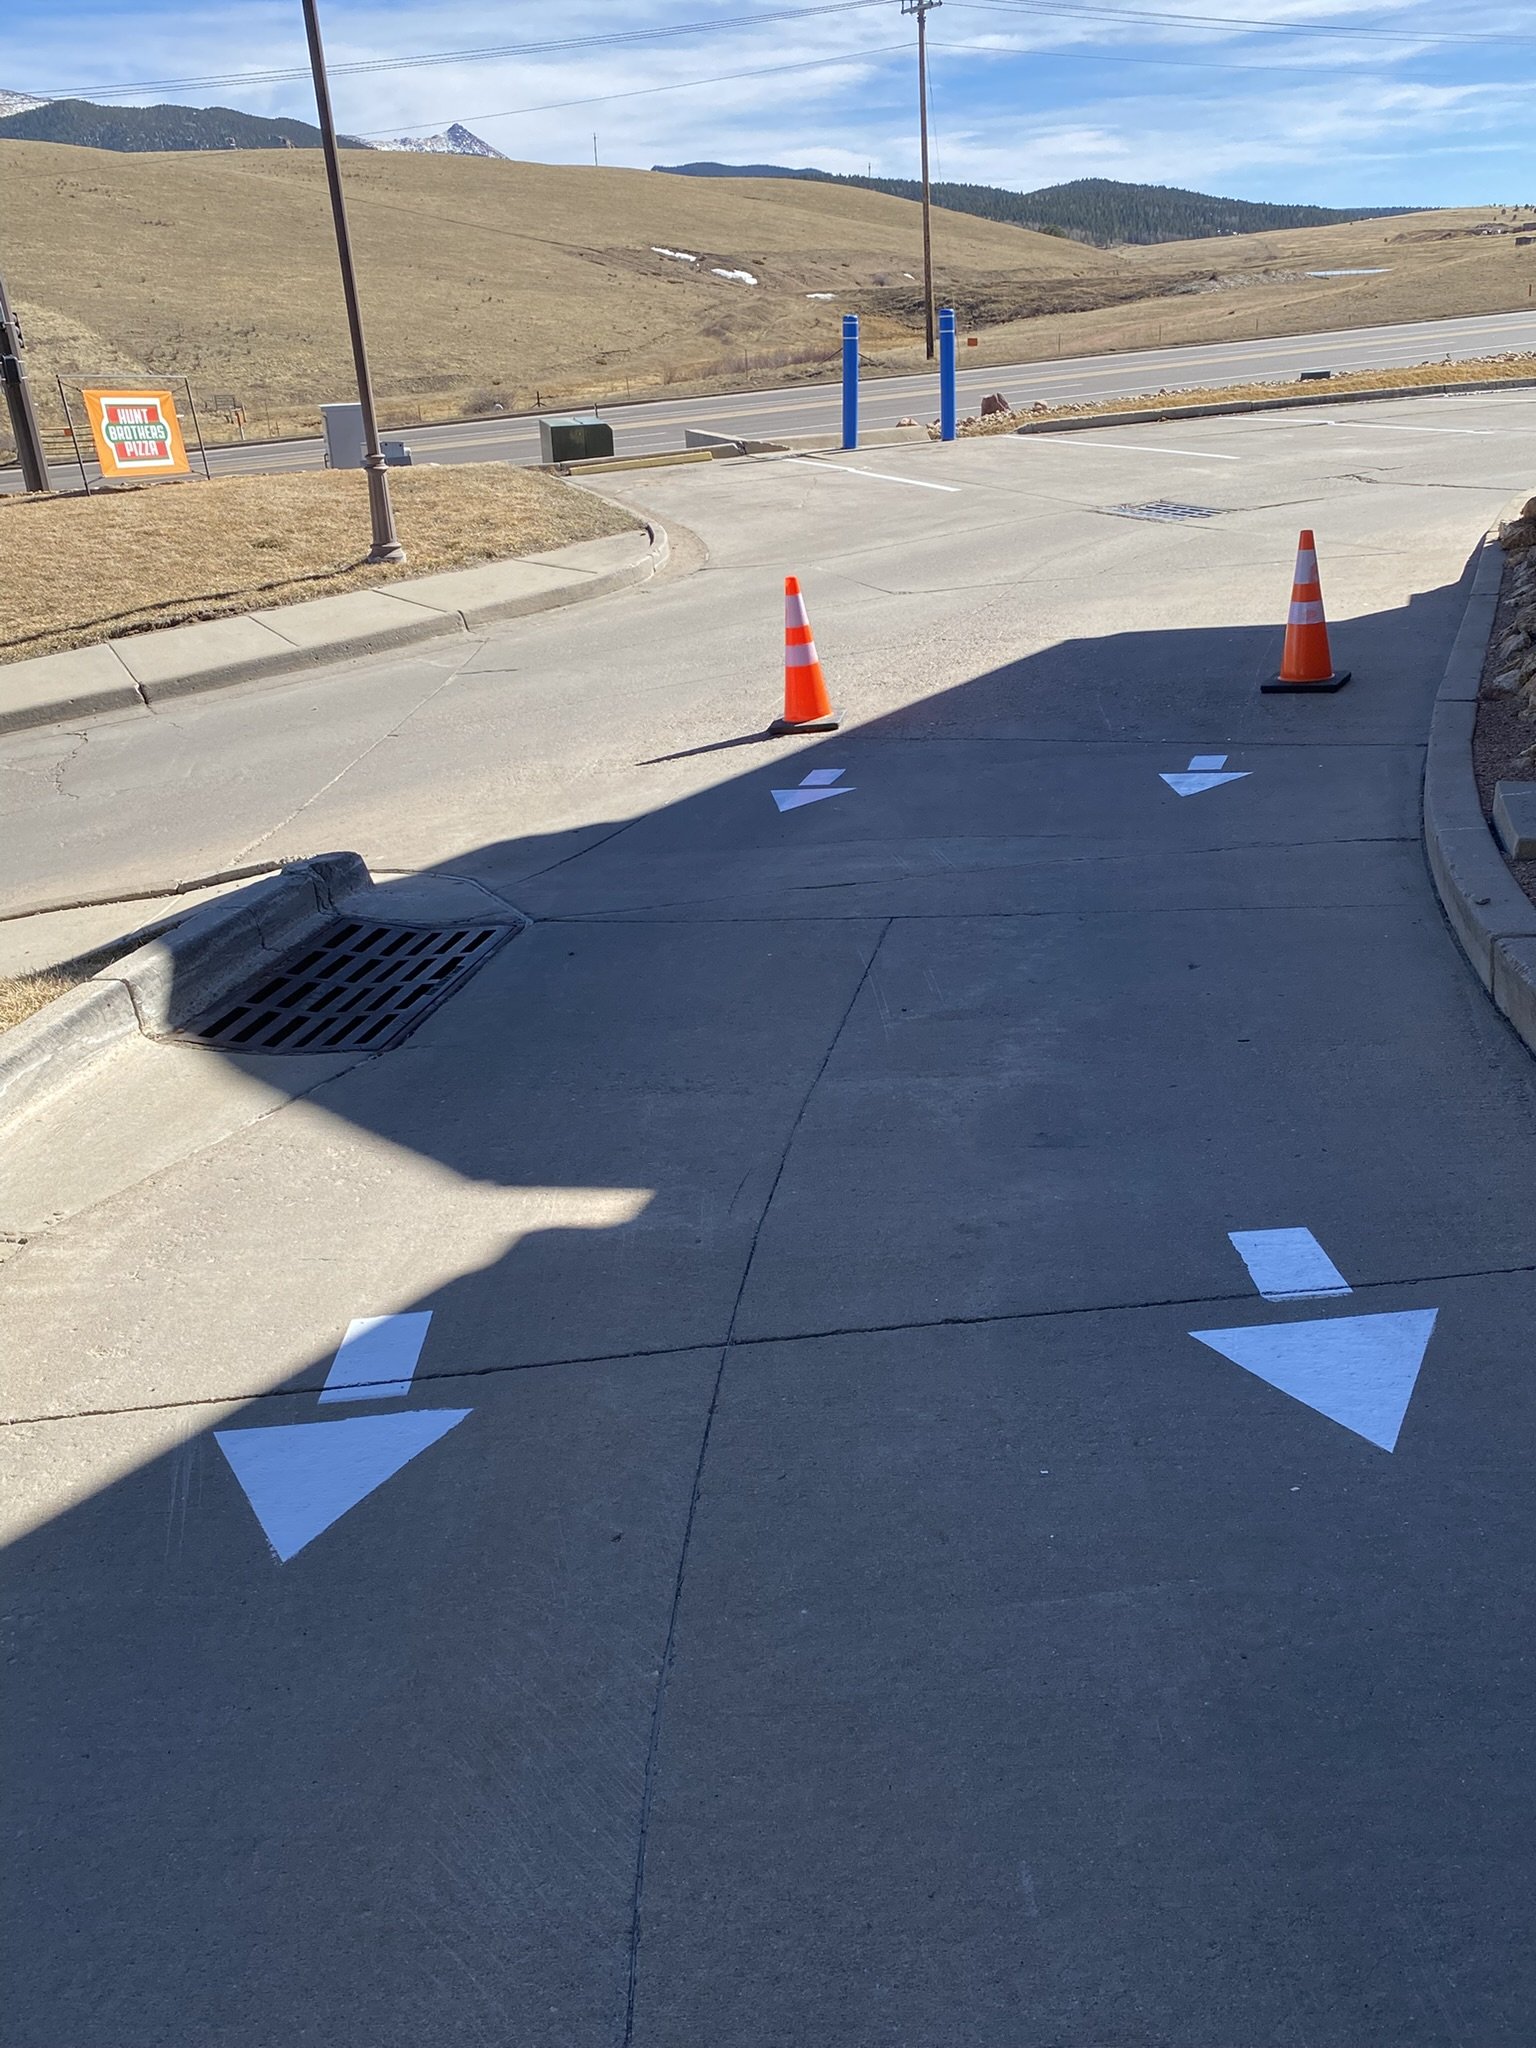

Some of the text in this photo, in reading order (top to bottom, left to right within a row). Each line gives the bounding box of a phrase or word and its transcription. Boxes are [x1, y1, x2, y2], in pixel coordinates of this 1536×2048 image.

[116, 408, 149, 424] HUNT
[107, 425, 166, 441] BROTHERS
[124, 441, 159, 456] PIZZA
